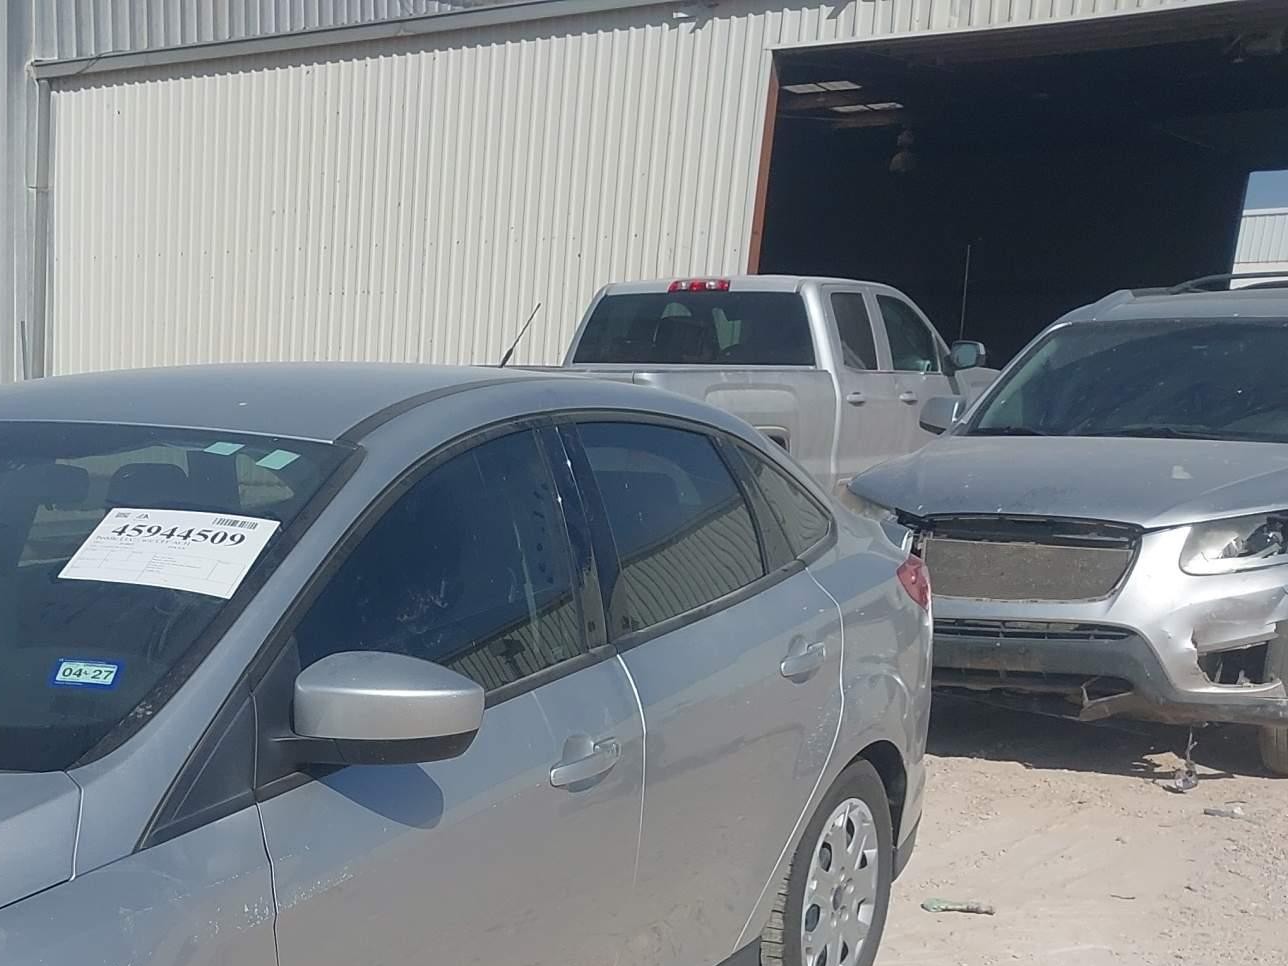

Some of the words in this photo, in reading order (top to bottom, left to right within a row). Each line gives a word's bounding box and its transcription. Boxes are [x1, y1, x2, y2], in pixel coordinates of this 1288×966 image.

[111, 523, 246, 547] 45944509
[62, 667, 84, 678] 04
[91, 669, 114, 680] 27
